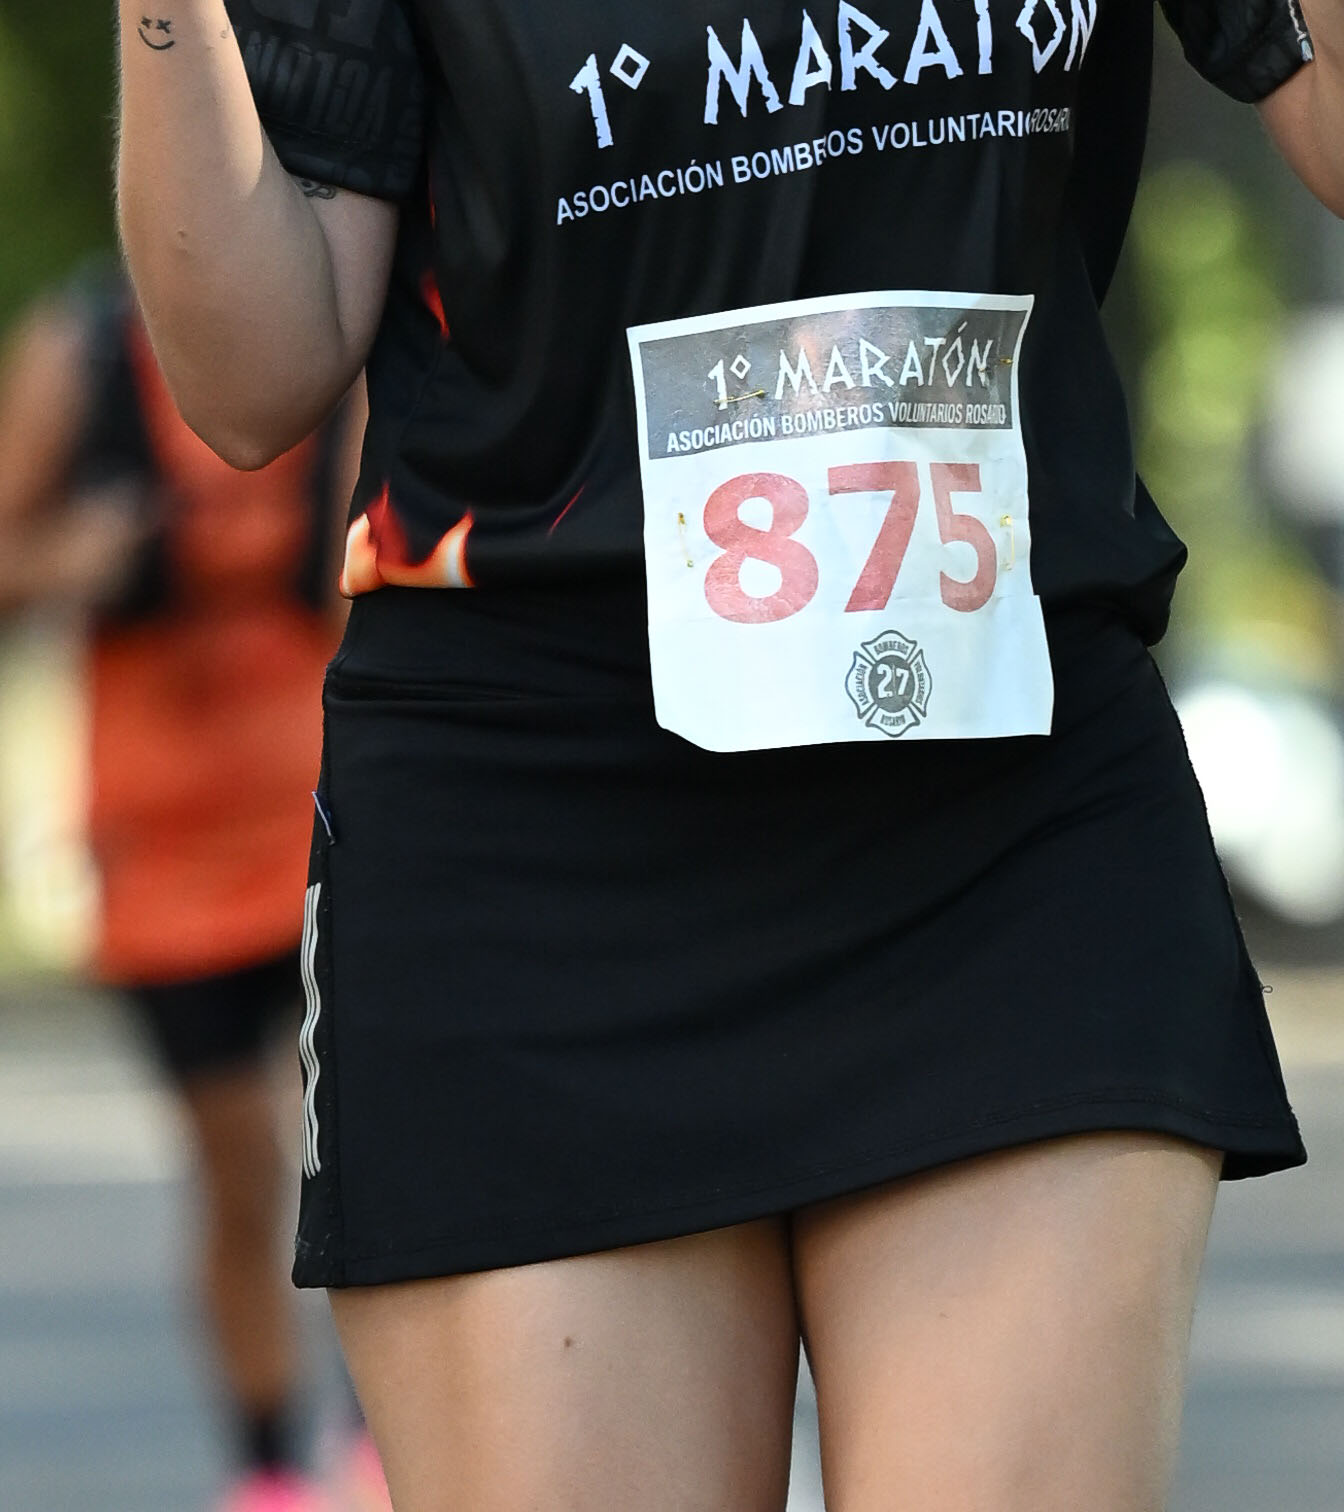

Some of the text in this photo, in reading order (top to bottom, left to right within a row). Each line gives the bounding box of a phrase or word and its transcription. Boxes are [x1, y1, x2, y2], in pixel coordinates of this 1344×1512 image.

[556, 159, 725, 226] ASOCIACIÓN
[871, 109, 1031, 153] VOLUNTARI
[775, 321, 994, 400] MARATÓN
[666, 412, 776, 454] ASOCIACIÓN
[782, 402, 885, 436] BOMBEROS
[888, 401, 963, 425] VOLUNTARIOS
[702, 460, 998, 625] 875
[876, 663, 910, 699] 27
